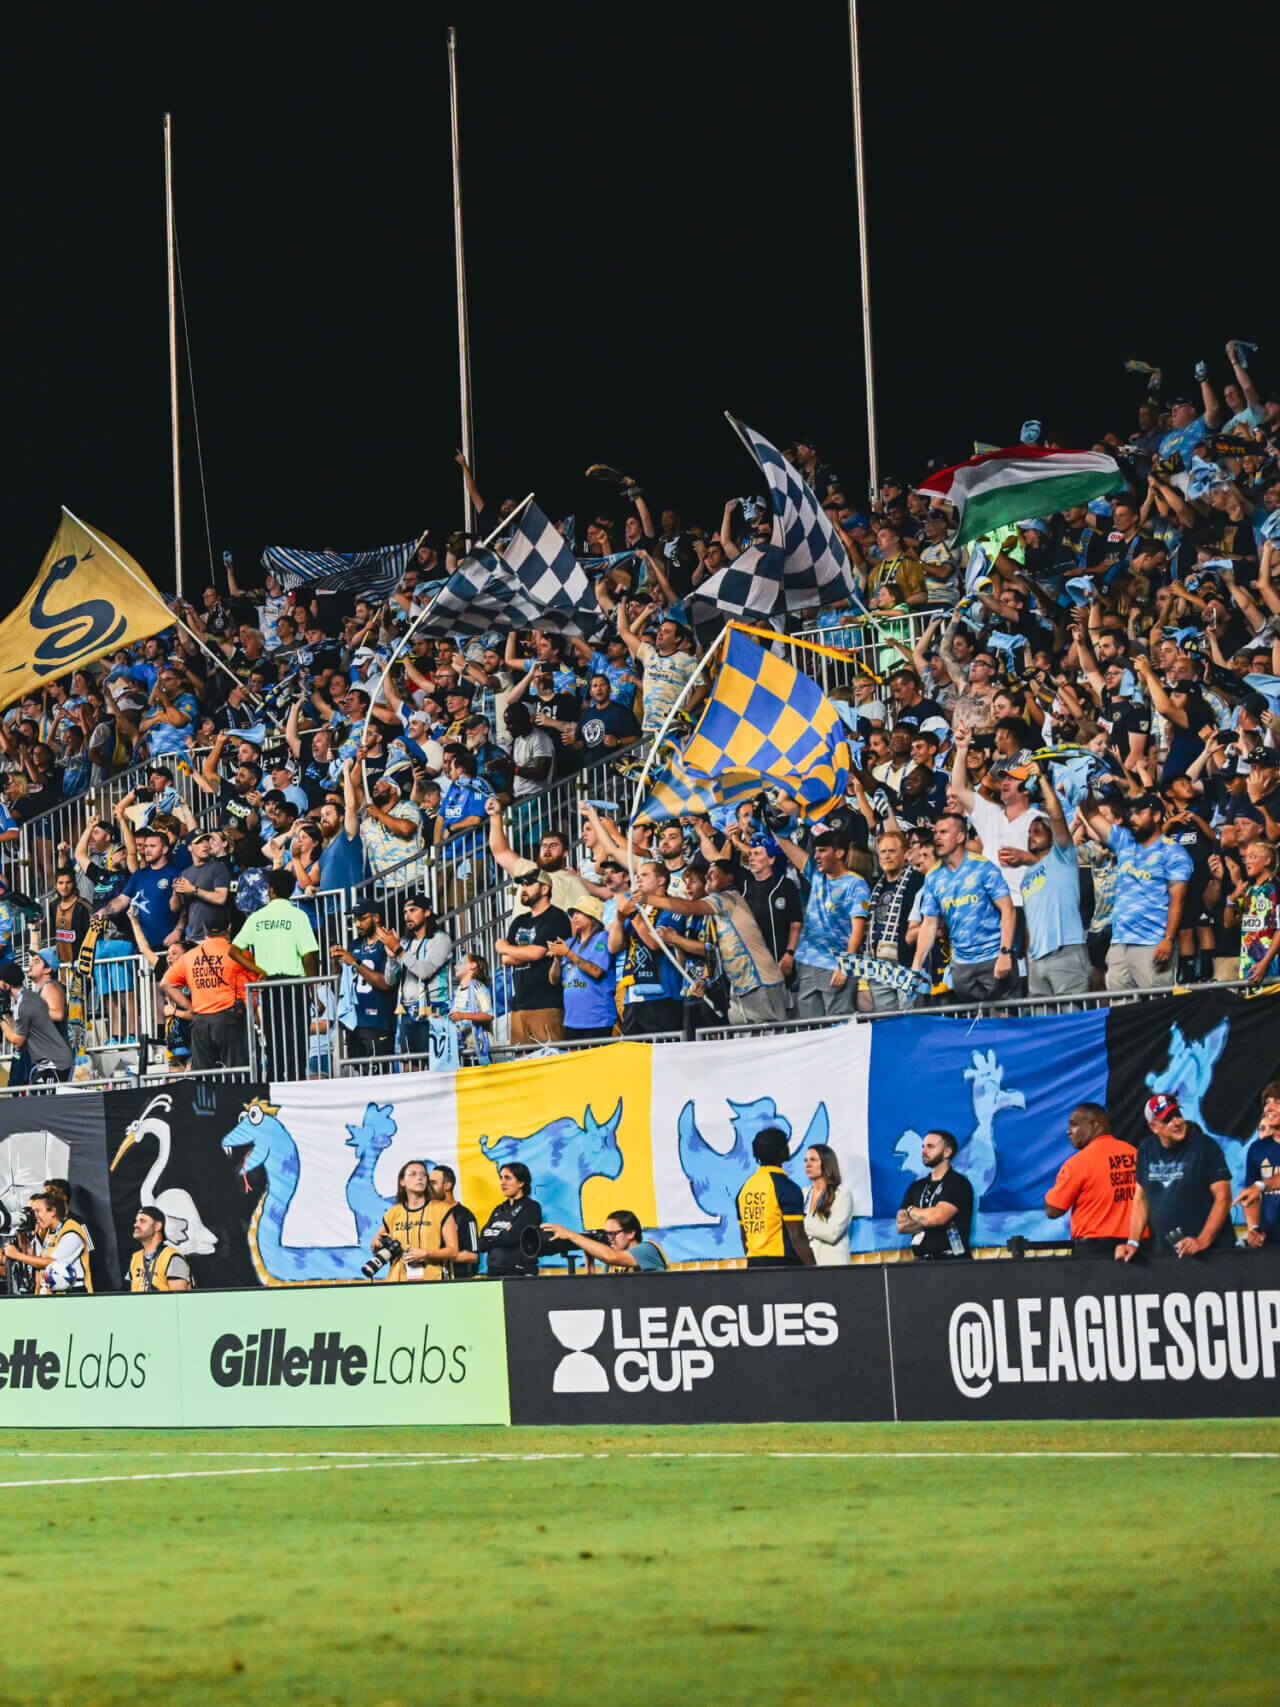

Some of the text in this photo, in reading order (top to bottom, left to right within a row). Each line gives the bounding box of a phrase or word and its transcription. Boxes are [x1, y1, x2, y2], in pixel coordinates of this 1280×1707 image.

[255, 919, 292, 932] STEWARD
[193, 954, 224, 967] APEX
[191, 966, 225, 979] SECURITY
[195, 977, 224, 990] GROUP
[1108, 1153, 1136, 1169] APEX
[1110, 1169, 1136, 1186] SECURIT
[744, 1192, 767, 1205] CSC
[743, 1205, 766, 1220] EVENT
[611, 1302, 839, 1350] LEAGUES
[948, 1290, 1280, 1398] @LEAGUESCUP
[65, 1332, 146, 1389] Labs
[210, 1323, 467, 1388] Gillette Labs
[614, 1349, 714, 1393] CUP
